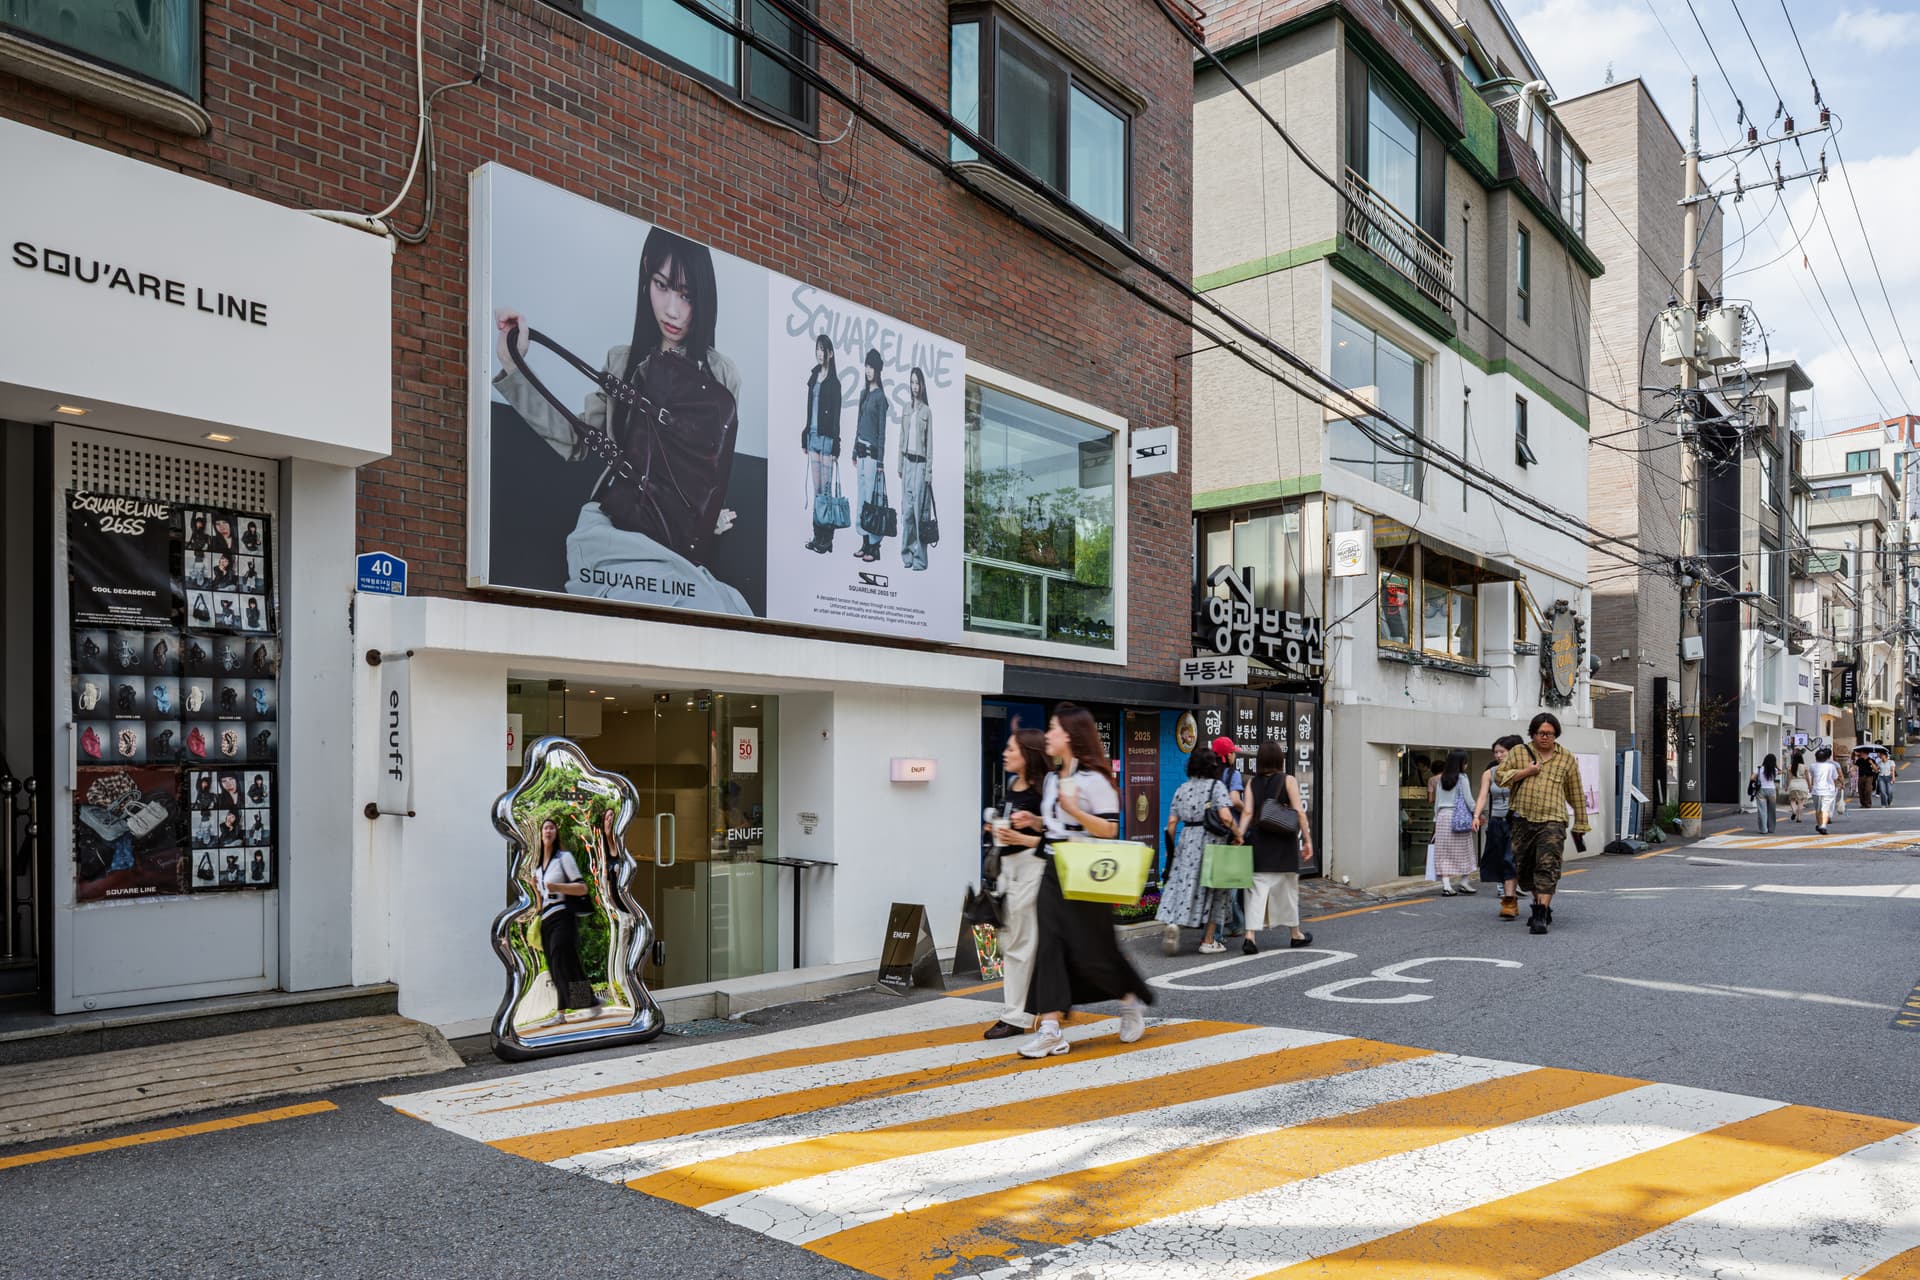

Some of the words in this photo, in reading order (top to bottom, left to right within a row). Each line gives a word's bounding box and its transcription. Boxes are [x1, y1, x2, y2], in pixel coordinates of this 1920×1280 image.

[197, 288, 268, 326] LINE
[72, 490, 169, 520] SQUARELINE
[100, 516, 146, 535] 26SS
[371, 560, 392, 576] 40
[114, 588, 156, 596] DECADENCE
[662, 579, 696, 597] LINE
[1184, 660, 1234, 680] 부동산
[389, 690, 403, 782] enuff
[1134, 731, 1151, 741] 2025
[1236, 725, 1256, 739] 부동산
[1266, 726, 1286, 740] 부동산
[739, 744, 752, 756] 50
[728, 828, 763, 840] ENUFF
[893, 931, 911, 939] ENUFF
